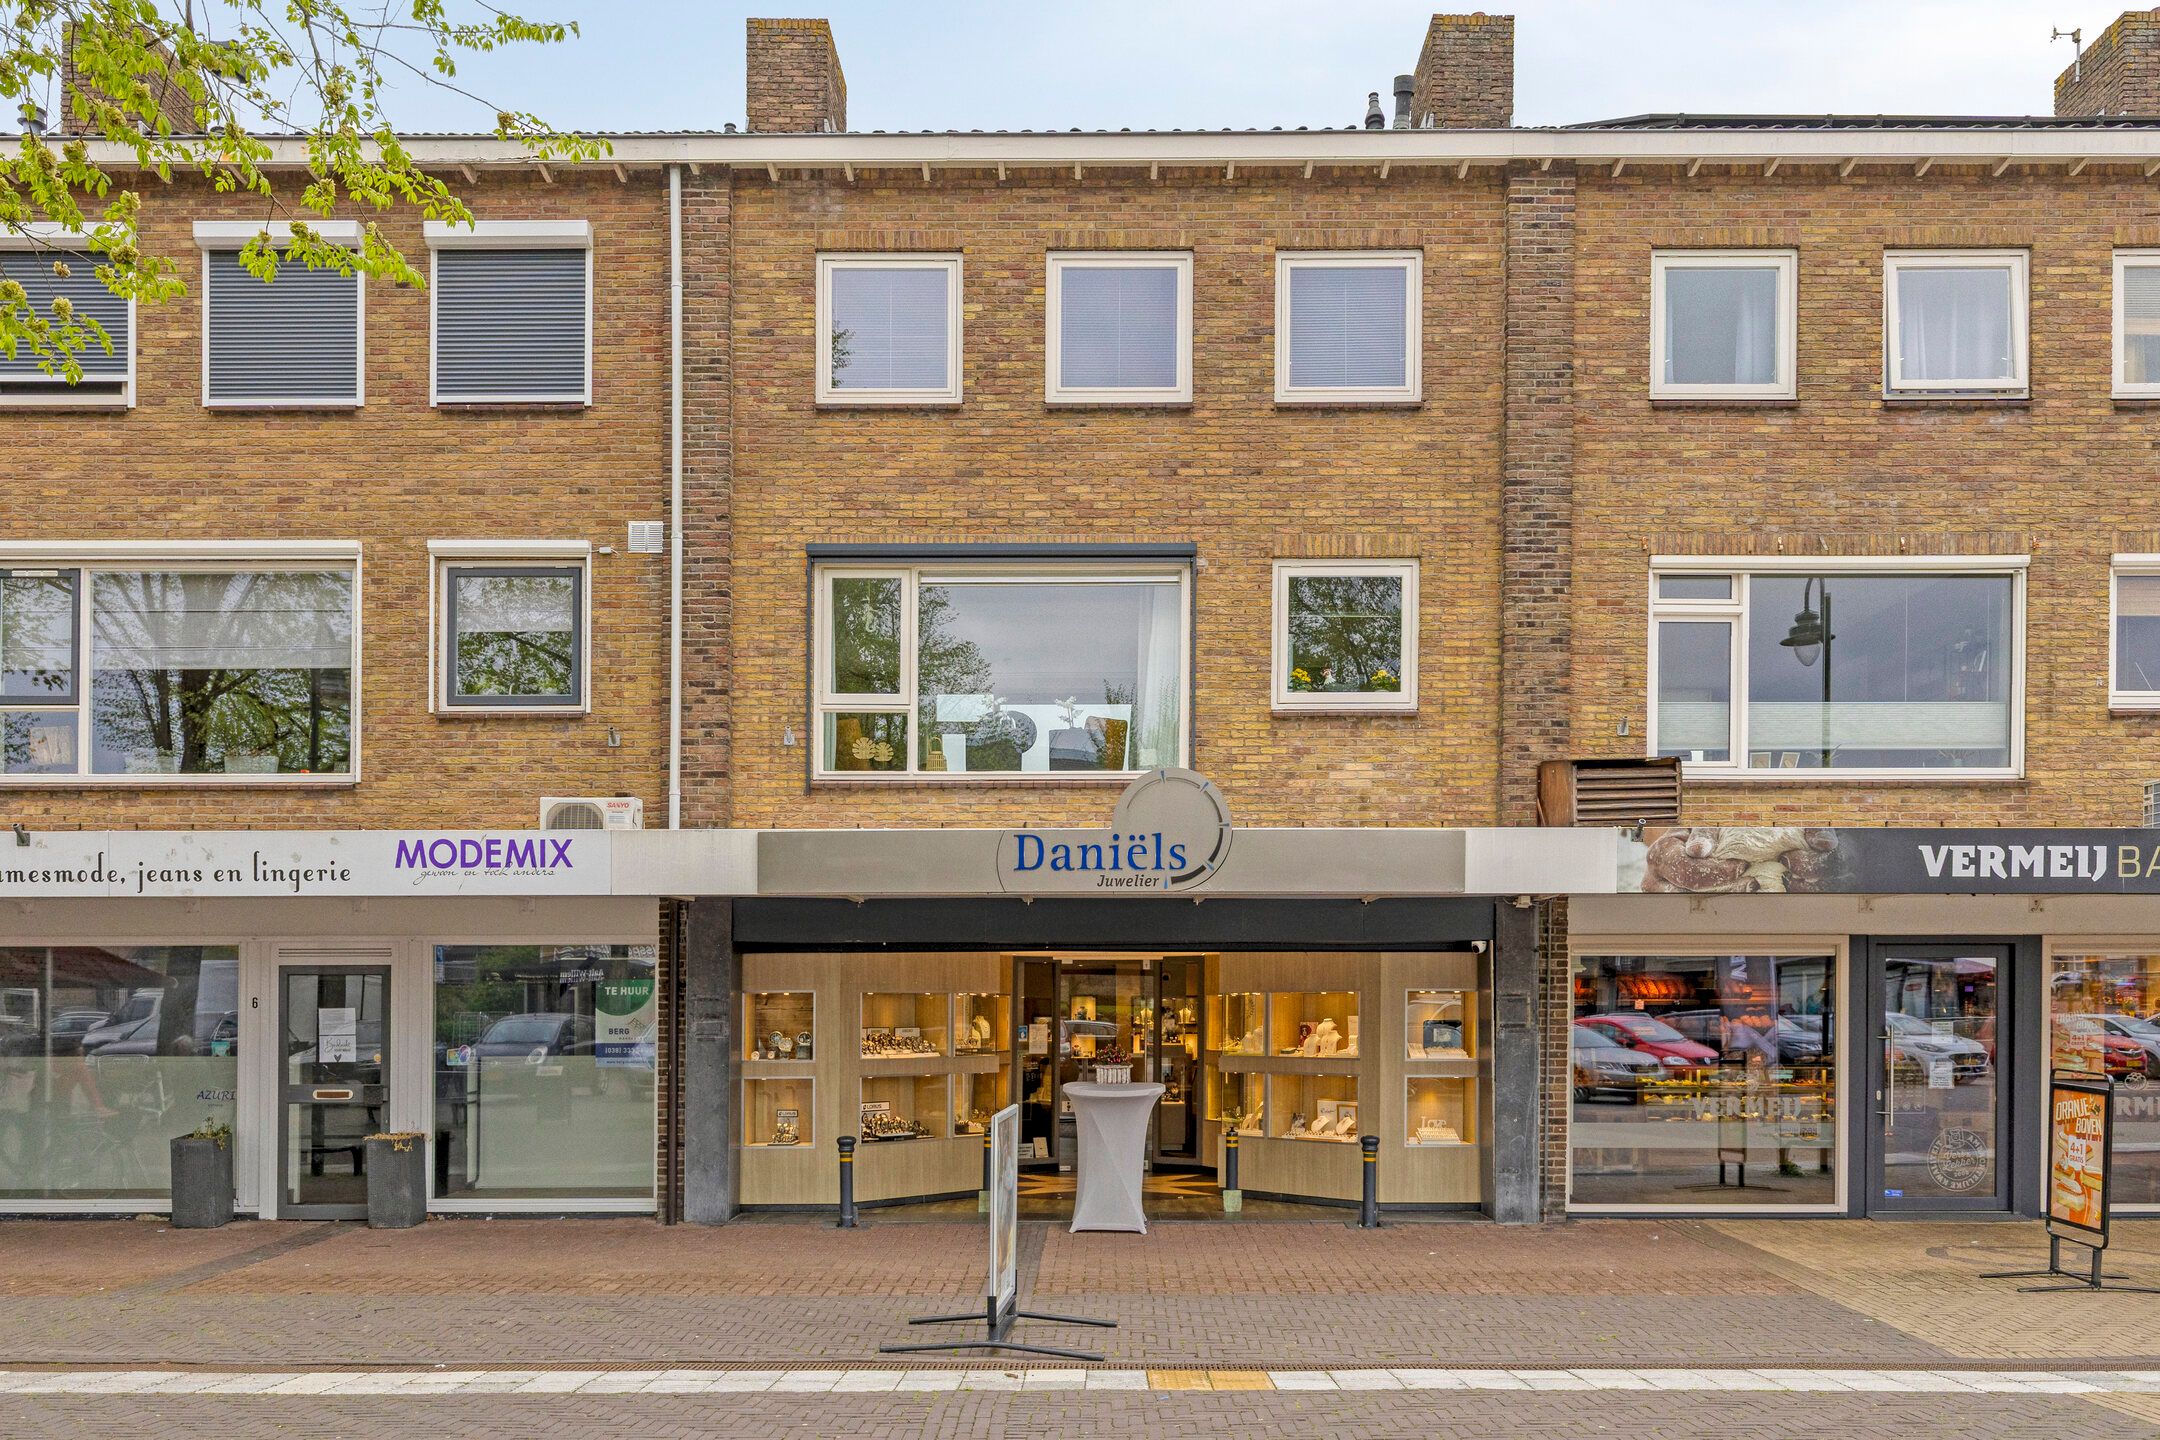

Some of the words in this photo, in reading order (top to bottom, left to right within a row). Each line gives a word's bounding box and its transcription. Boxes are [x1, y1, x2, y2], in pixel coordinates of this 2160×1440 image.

[394, 838, 574, 869] MODEMIX
[1013, 832, 1187, 872] Daniëls
[1918, 844, 2108, 882] VERMEIJ
[137, 861, 203, 894] jeans
[213, 868, 243, 883] en
[253, 850, 351, 893] lingerie
[412, 869, 458, 886] gewoon
[1096, 874, 1160, 888] Juwelier
[604, 986, 618, 996] TE
[620, 986, 649, 996] HUUR
[252, 997, 258, 1009] 6
[608, 1027, 630, 1035] BERG
[2056, 1098, 2090, 1121] ORANJE
[2076, 1118, 2102, 1135] BOVEN
[2070, 1142, 2083, 1155] 4+1
